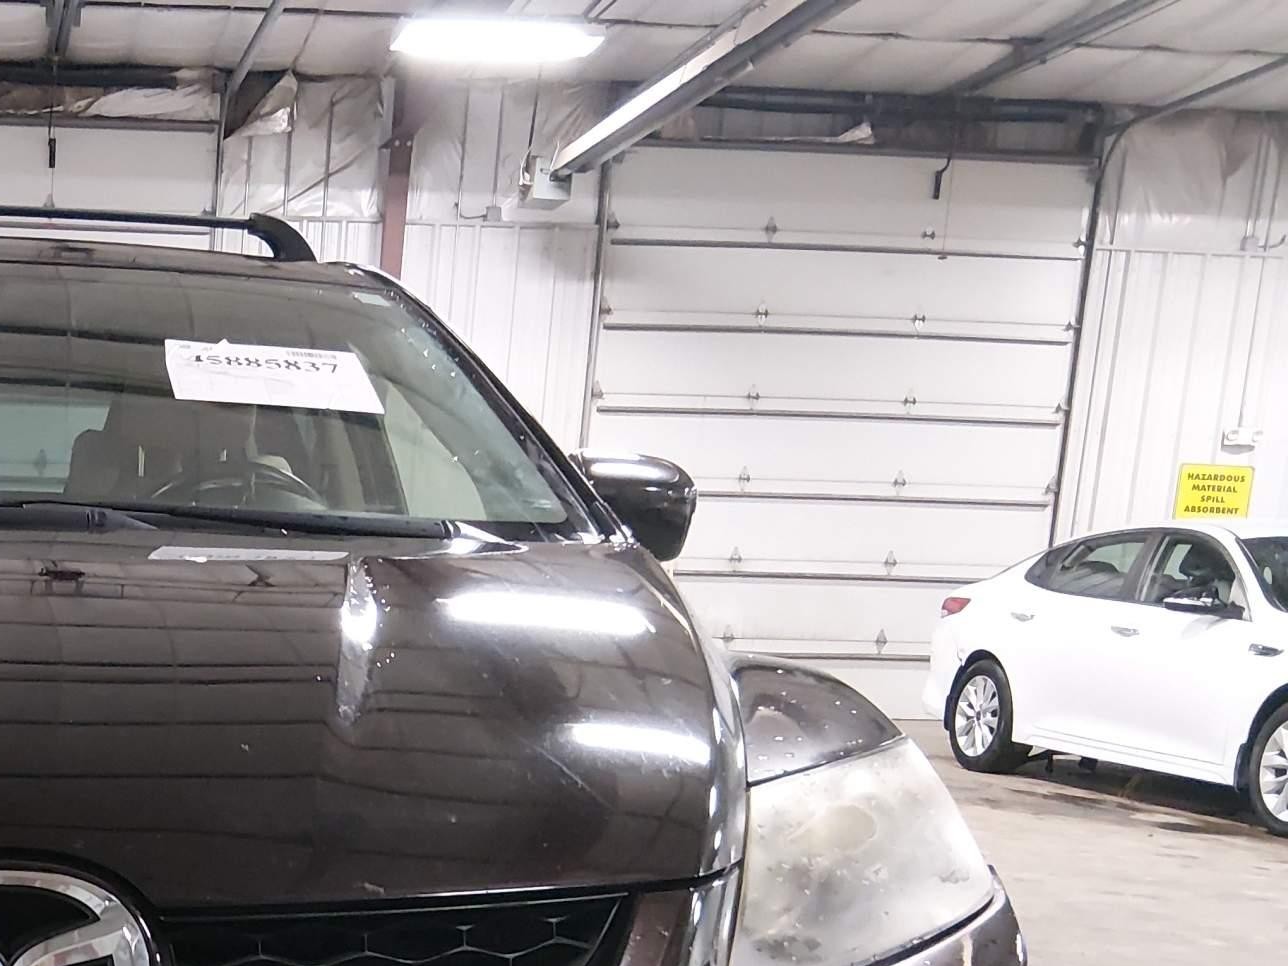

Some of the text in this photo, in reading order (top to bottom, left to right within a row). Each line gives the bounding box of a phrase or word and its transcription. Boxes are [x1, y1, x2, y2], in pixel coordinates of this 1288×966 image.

[1187, 472, 1246, 483] HAZARDOUS
[1192, 484, 1238, 494] MATERIAL
[1200, 495, 1226, 504] SPILL
[1184, 505, 1240, 515] ABSORBENT
